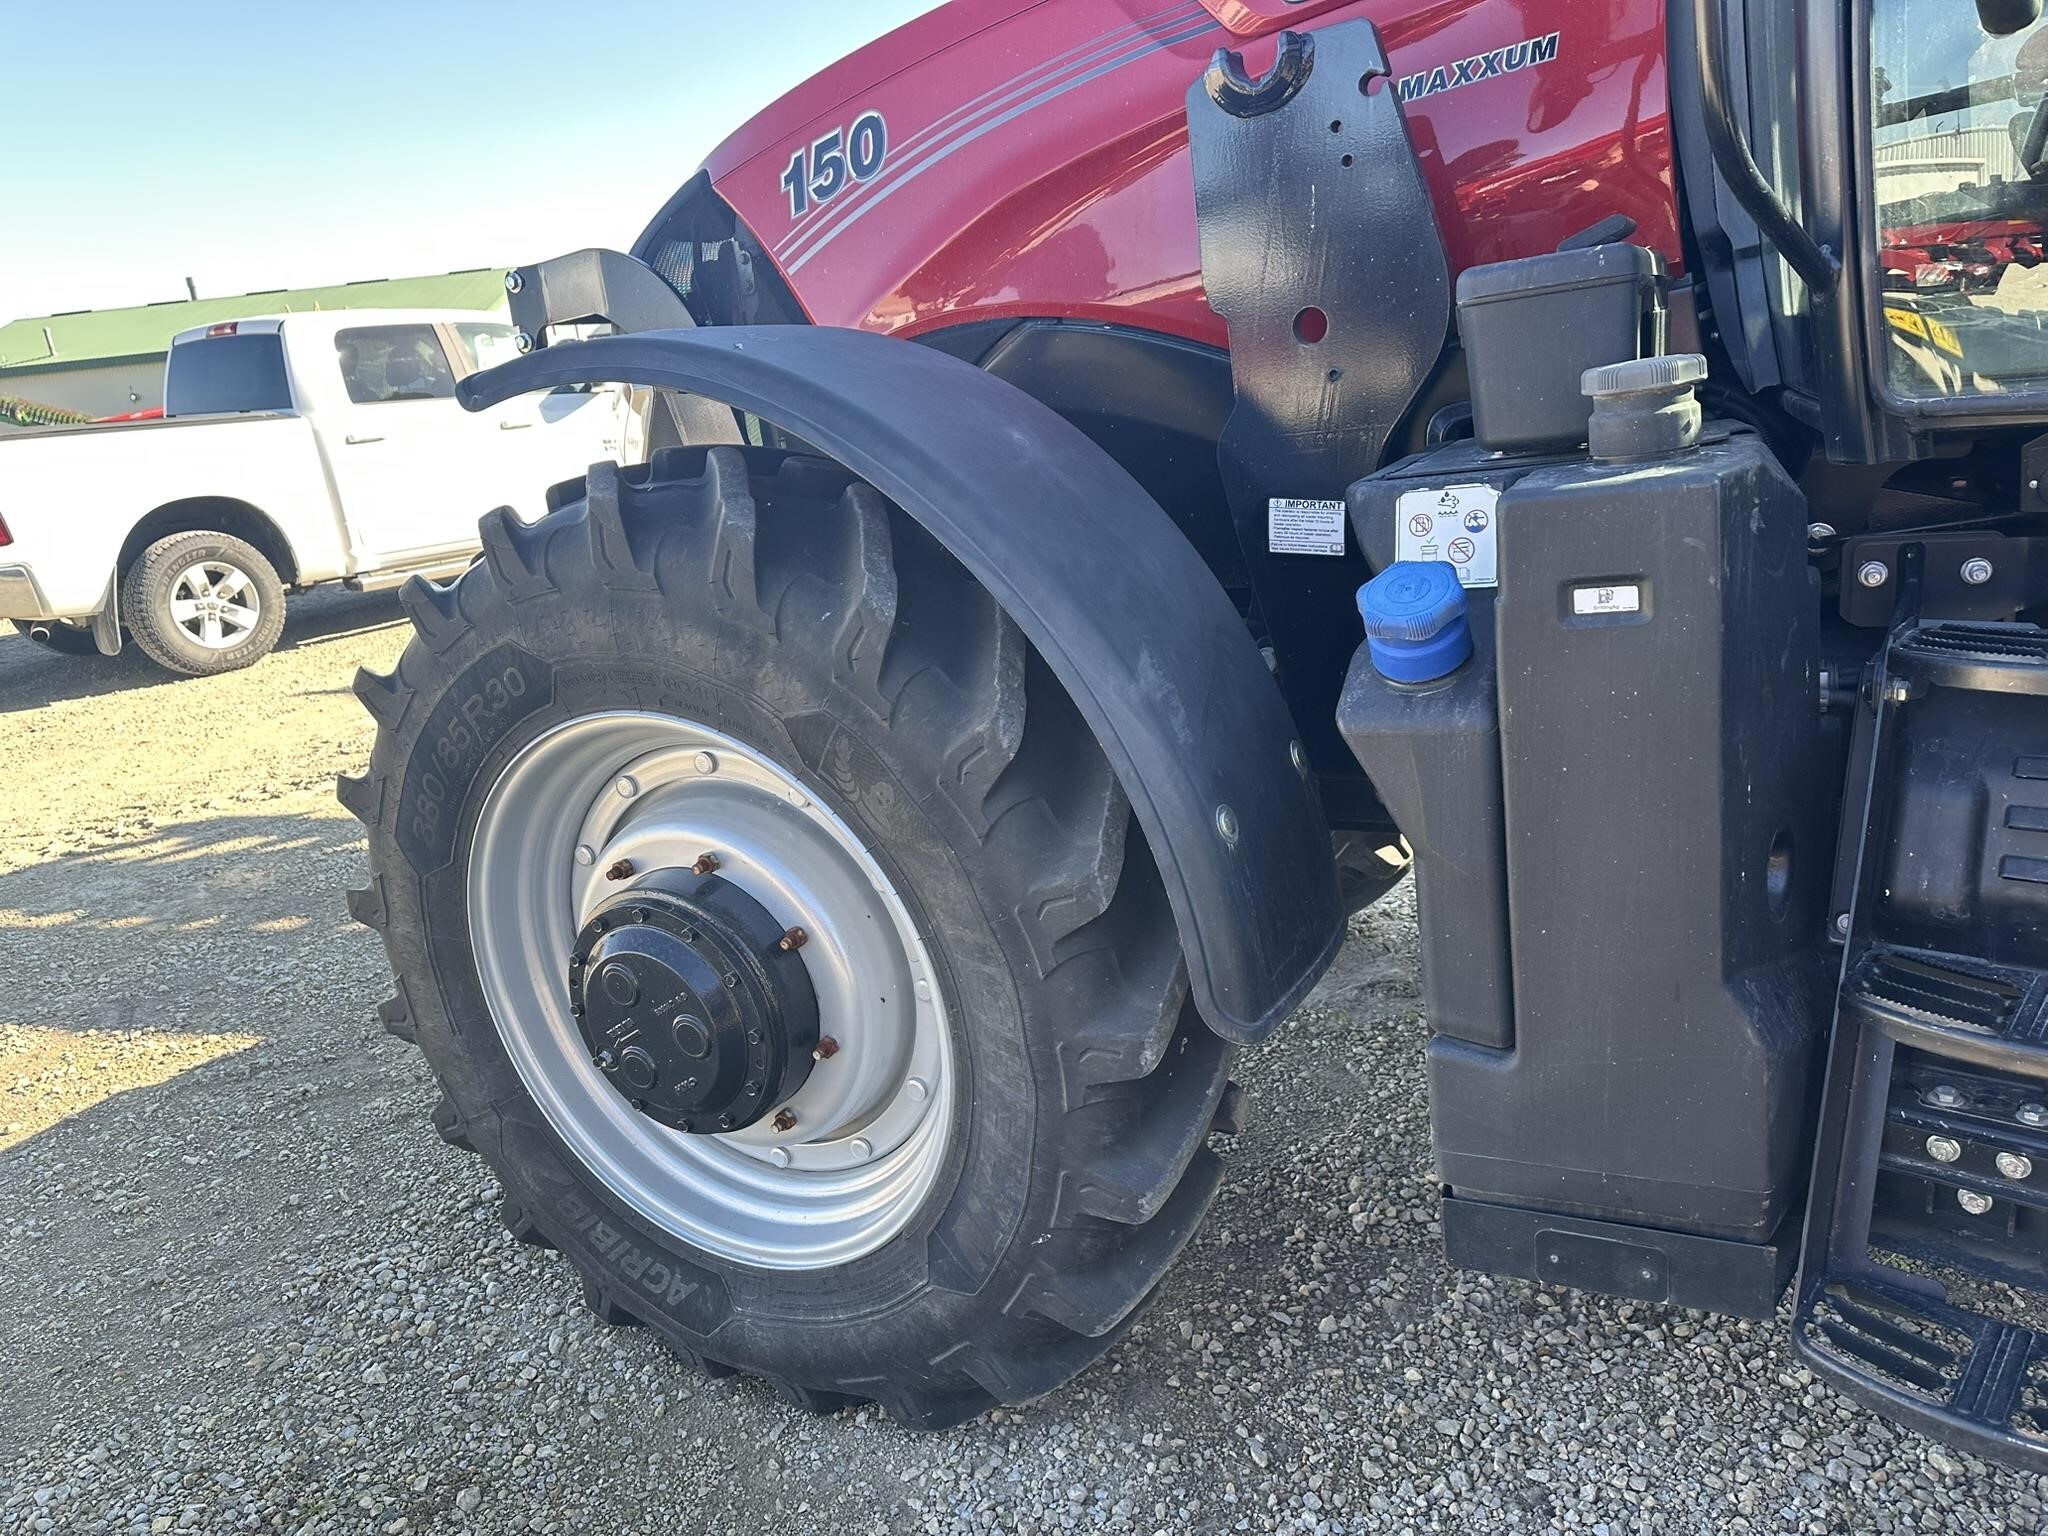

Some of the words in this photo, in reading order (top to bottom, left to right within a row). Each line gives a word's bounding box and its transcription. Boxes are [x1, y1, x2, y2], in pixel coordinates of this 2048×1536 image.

[1398, 30, 1561, 102] MAXXUM
[780, 108, 887, 220] 150
[1284, 500, 1343, 510] IMPORTANT
[411, 665, 527, 847] 380/85R30
